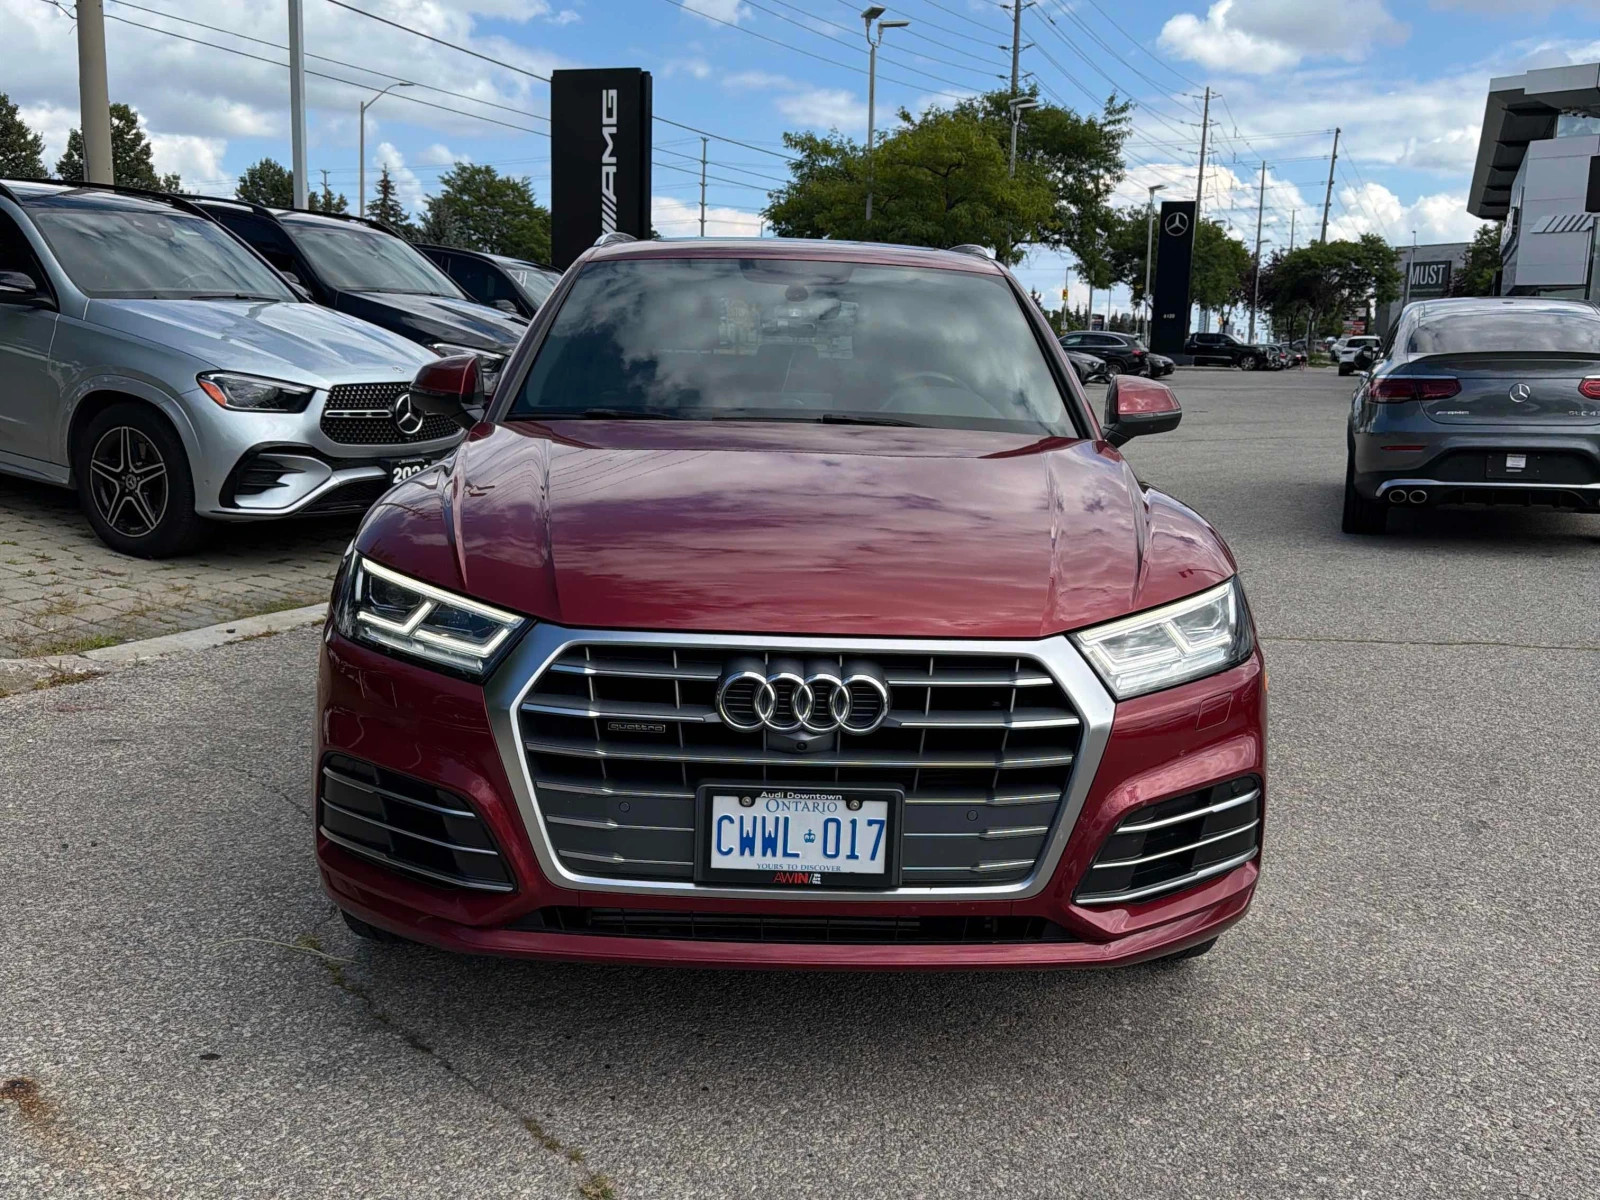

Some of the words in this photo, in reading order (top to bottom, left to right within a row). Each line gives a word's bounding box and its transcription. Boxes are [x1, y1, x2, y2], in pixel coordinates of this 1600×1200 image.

[602, 89, 617, 204] AMG
[1410, 264, 1446, 286] MUST
[393, 464, 429, 484] 20
[610, 723, 663, 732] quattro
[760, 791, 784, 799] Audi
[787, 791, 842, 801] Downtown
[765, 799, 838, 815] ONTARIO
[716, 814, 801, 858] CWWL
[822, 817, 886, 861] 017
[757, 863, 784, 871] YOURS
[787, 863, 797, 871] TO
[800, 864, 842, 872] DISCOVER
